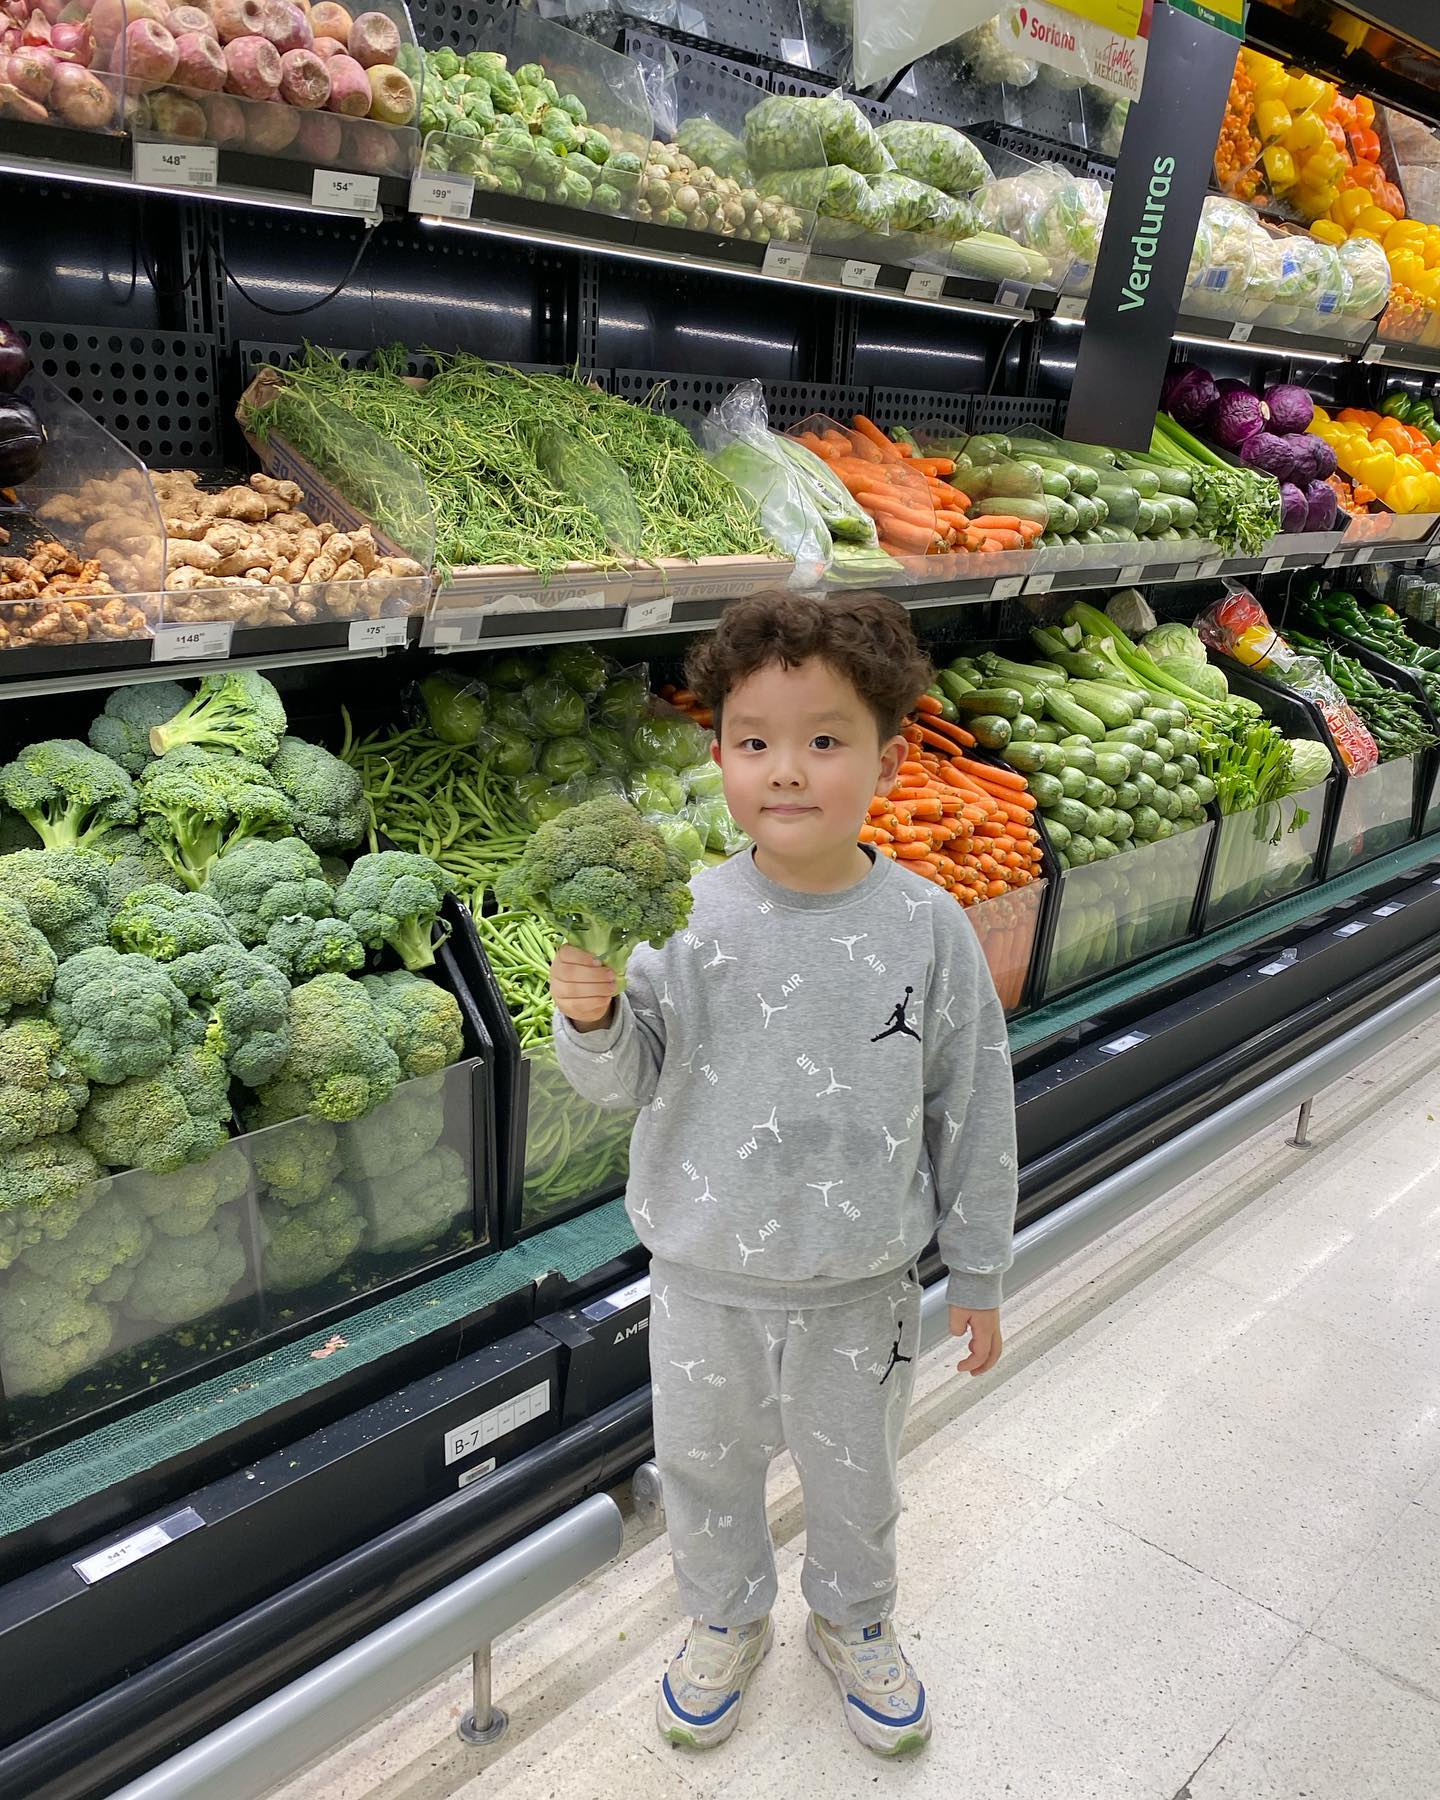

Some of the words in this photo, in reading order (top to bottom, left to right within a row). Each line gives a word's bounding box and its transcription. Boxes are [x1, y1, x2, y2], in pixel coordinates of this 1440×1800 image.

[1029, 17, 1076, 51] Soriana
[1093, 60, 1138, 92] MEXICANOS
[1117, 155, 1176, 312] Verduras
[672, 585, 690, 597] DE
[690, 582, 754, 596] GUAYABAS
[757, 899, 775, 915] IR
[682, 930, 705, 950] AIR
[863, 953, 887, 976] AIR
[780, 973, 804, 997] AIR
[700, 1064, 719, 1086] AIR
[796, 1053, 820, 1075] AIR
[905, 1104, 921, 1129] AIR
[737, 1136, 758, 1160] AIR
[682, 1159, 700, 1181] AIR
[837, 1199, 862, 1222] AIR
[757, 1218, 782, 1241] AIR
[702, 1373, 727, 1387] AIR
[455, 1430, 480, 1455] B-7
[717, 1515, 733, 1529] AIR
